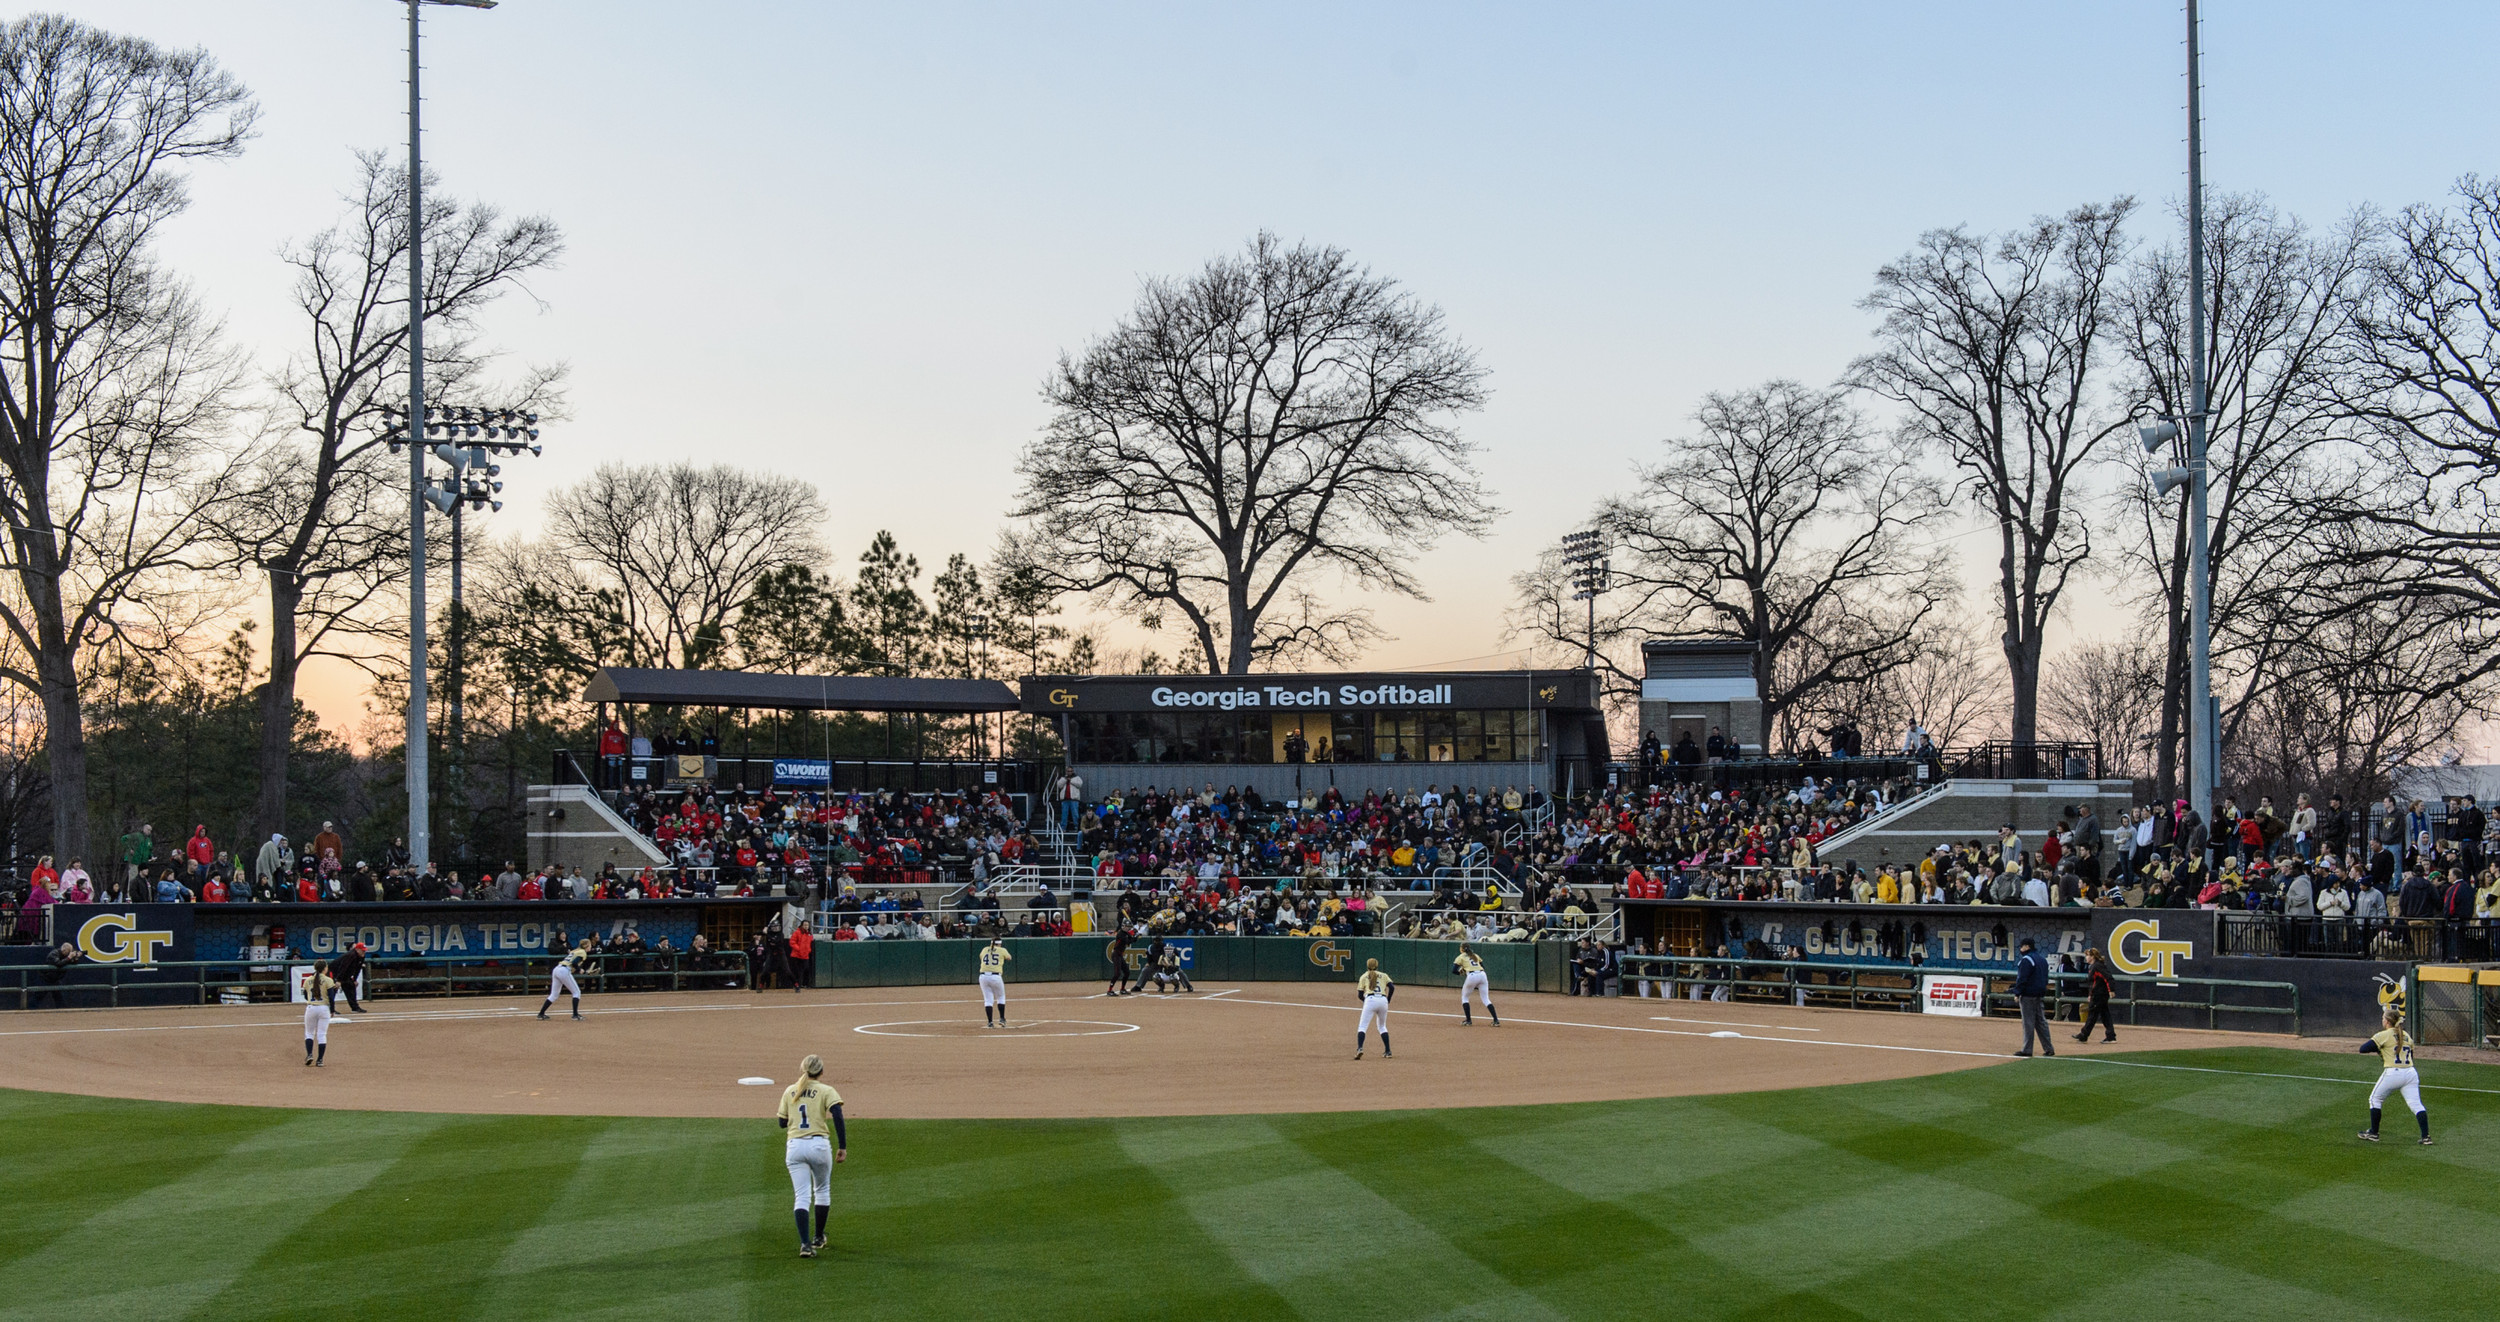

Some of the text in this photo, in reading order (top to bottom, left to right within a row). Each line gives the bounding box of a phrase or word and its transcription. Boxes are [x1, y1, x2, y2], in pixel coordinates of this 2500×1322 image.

[1050, 689, 1078, 708] GT
[1151, 684, 1451, 711] Georgia Tech Softball
[788, 764, 830, 776] WORTH
[77, 913, 173, 971] GT
[310, 923, 565, 953] GEORGIA TECH
[1938, 931, 2014, 961] TECH
[983, 953, 999, 966] 45
[1309, 940, 1351, 971] GT
[2108, 919, 2193, 986] GT
[1930, 983, 1978, 1000] ESPN
[2394, 1046, 2411, 1064] 17
[799, 1104, 810, 1129] 1
